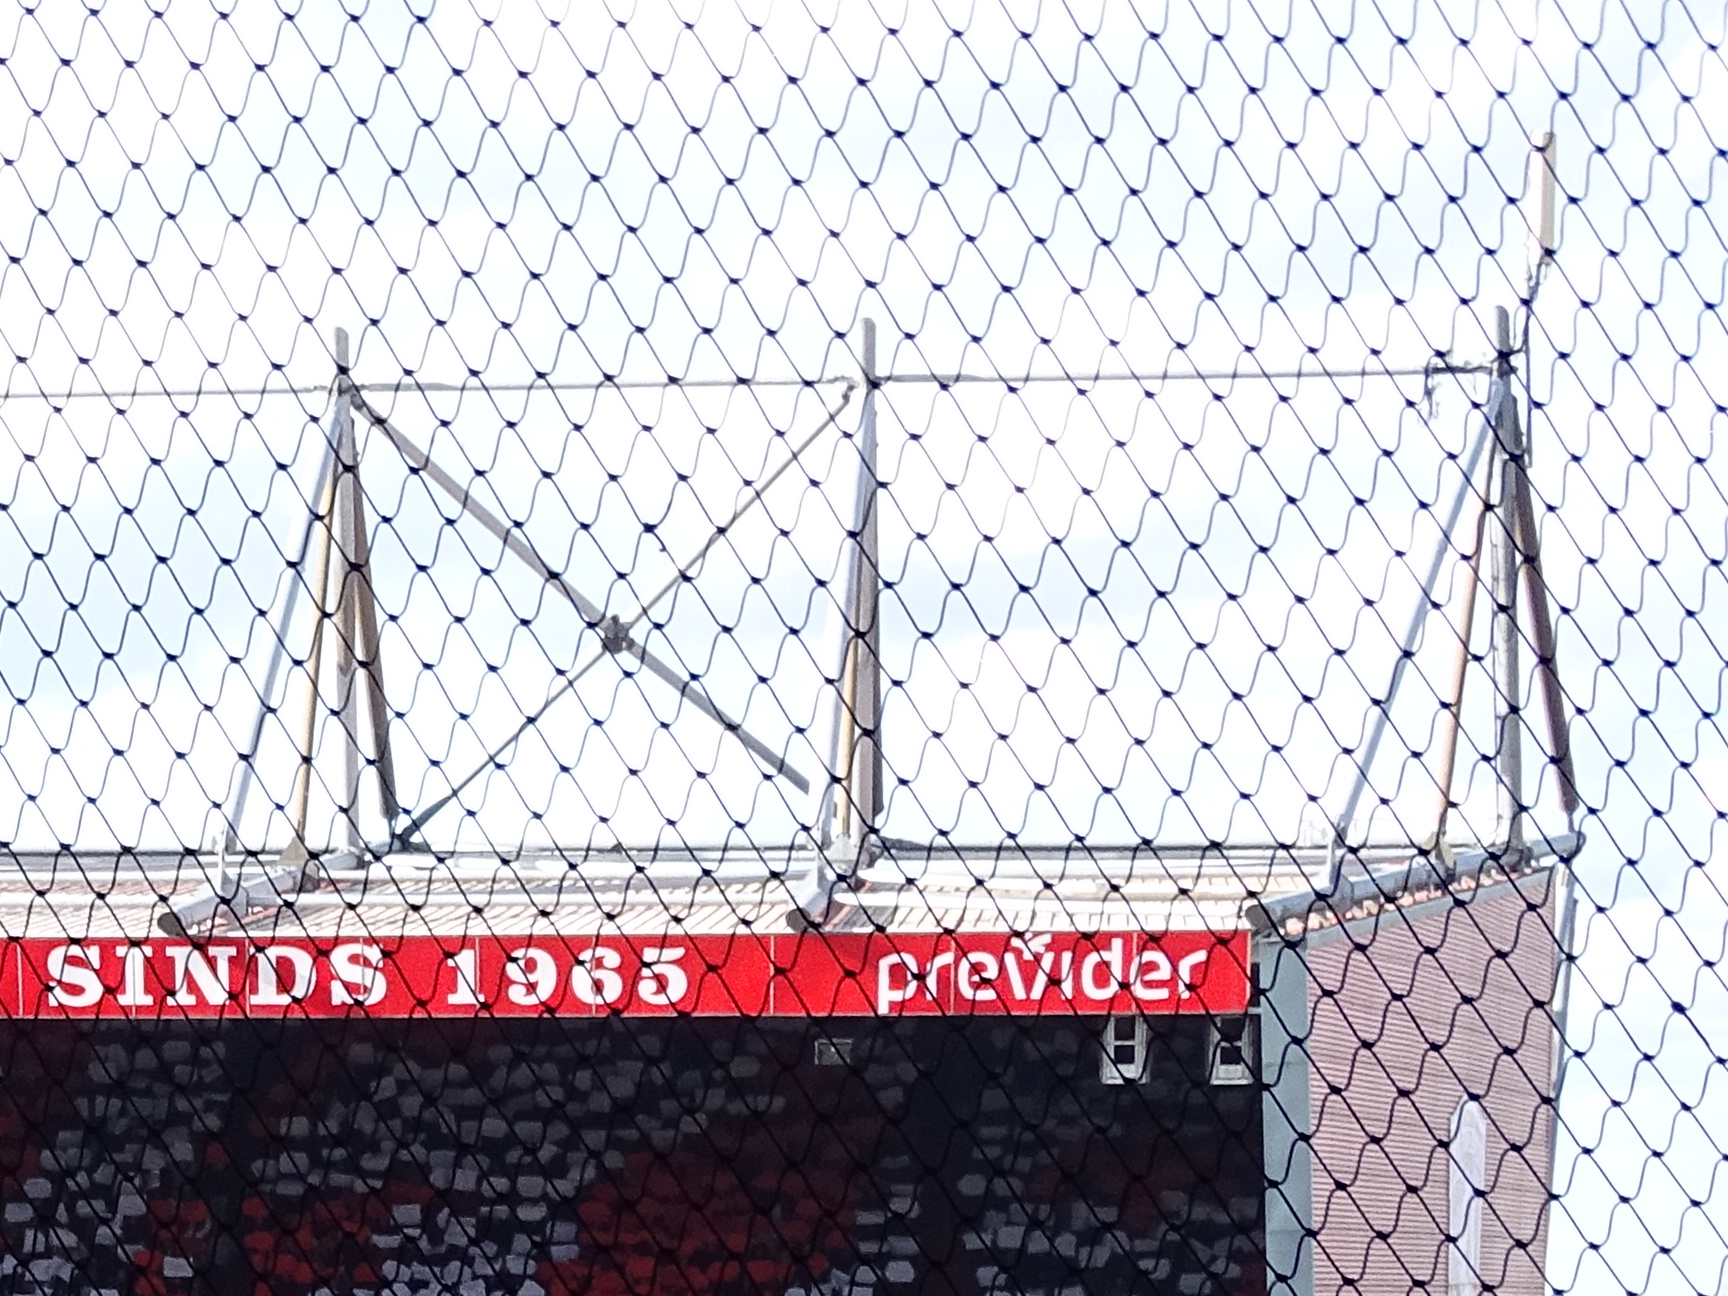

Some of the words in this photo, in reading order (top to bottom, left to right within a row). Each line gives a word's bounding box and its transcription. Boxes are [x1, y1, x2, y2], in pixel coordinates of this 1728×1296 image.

[46, 944, 388, 1008] SINDS
[446, 944, 690, 1006] 1965
[877, 934, 1209, 1012] previder
